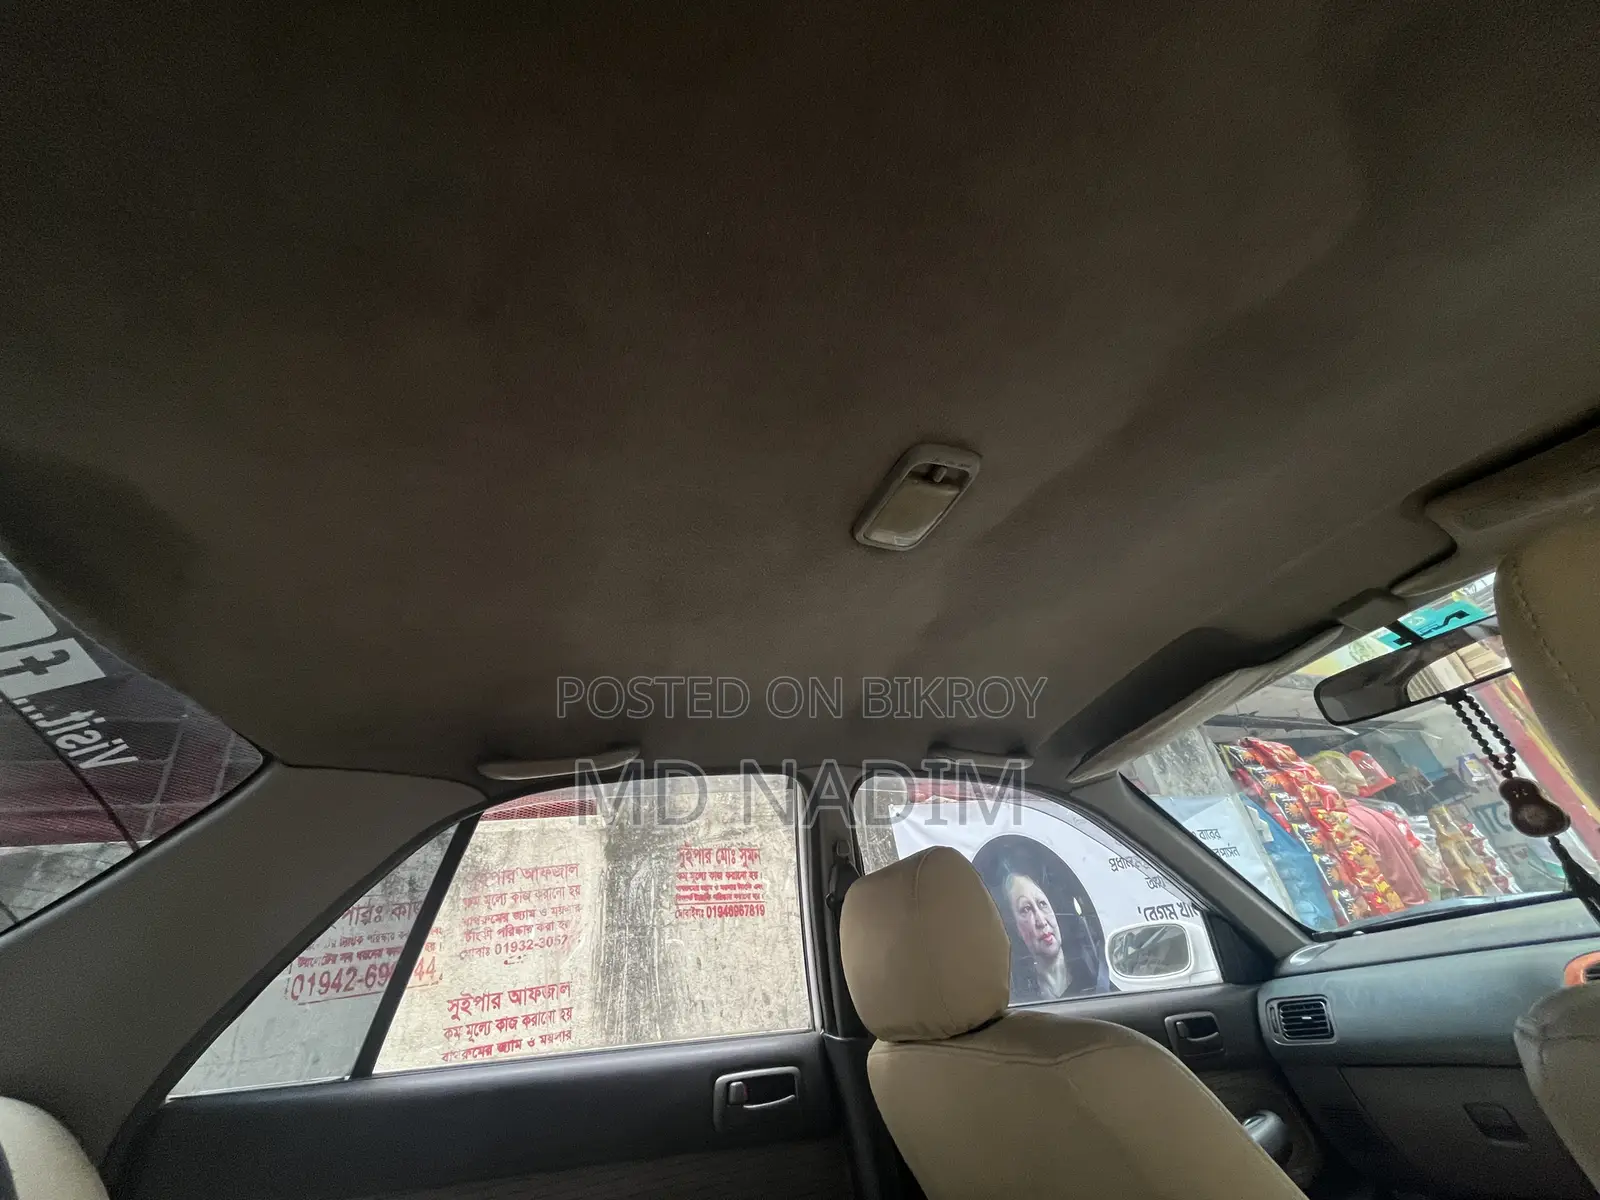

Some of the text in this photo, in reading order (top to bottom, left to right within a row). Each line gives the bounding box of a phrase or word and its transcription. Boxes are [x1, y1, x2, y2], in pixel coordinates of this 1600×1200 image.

[446, 981, 572, 1021] সুইপার আফজাল
[443, 1007, 574, 1042] কম মূল্যে কাজ করানো হয়
